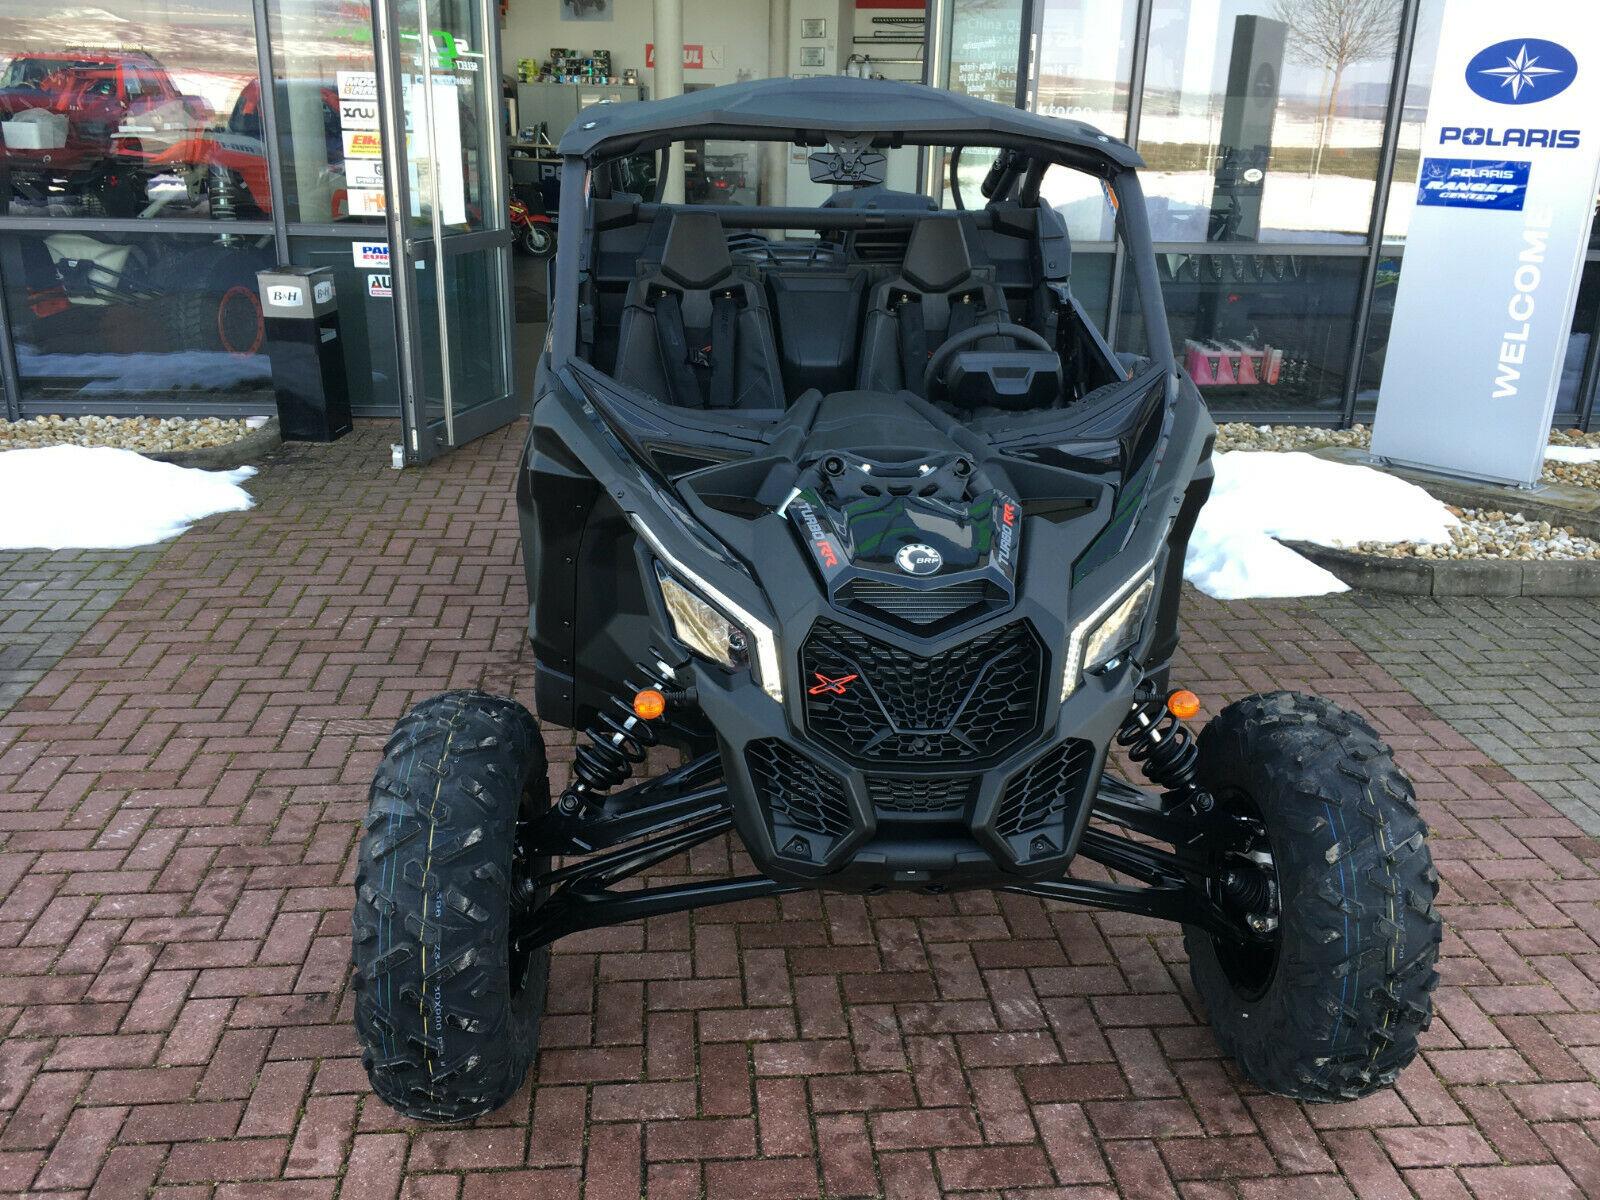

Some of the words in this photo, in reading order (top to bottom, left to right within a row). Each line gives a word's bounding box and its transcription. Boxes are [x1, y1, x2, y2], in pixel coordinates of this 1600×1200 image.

[1439, 126, 1581, 149] POLARIS
[1450, 167, 1514, 179] POLARIS
[1425, 181, 1517, 194] RANGER
[1438, 192, 1498, 202] CENTER
[1492, 203, 1551, 399] WELCOME
[798, 502, 826, 540] TURBO
[998, 524, 1013, 566] TURBO
